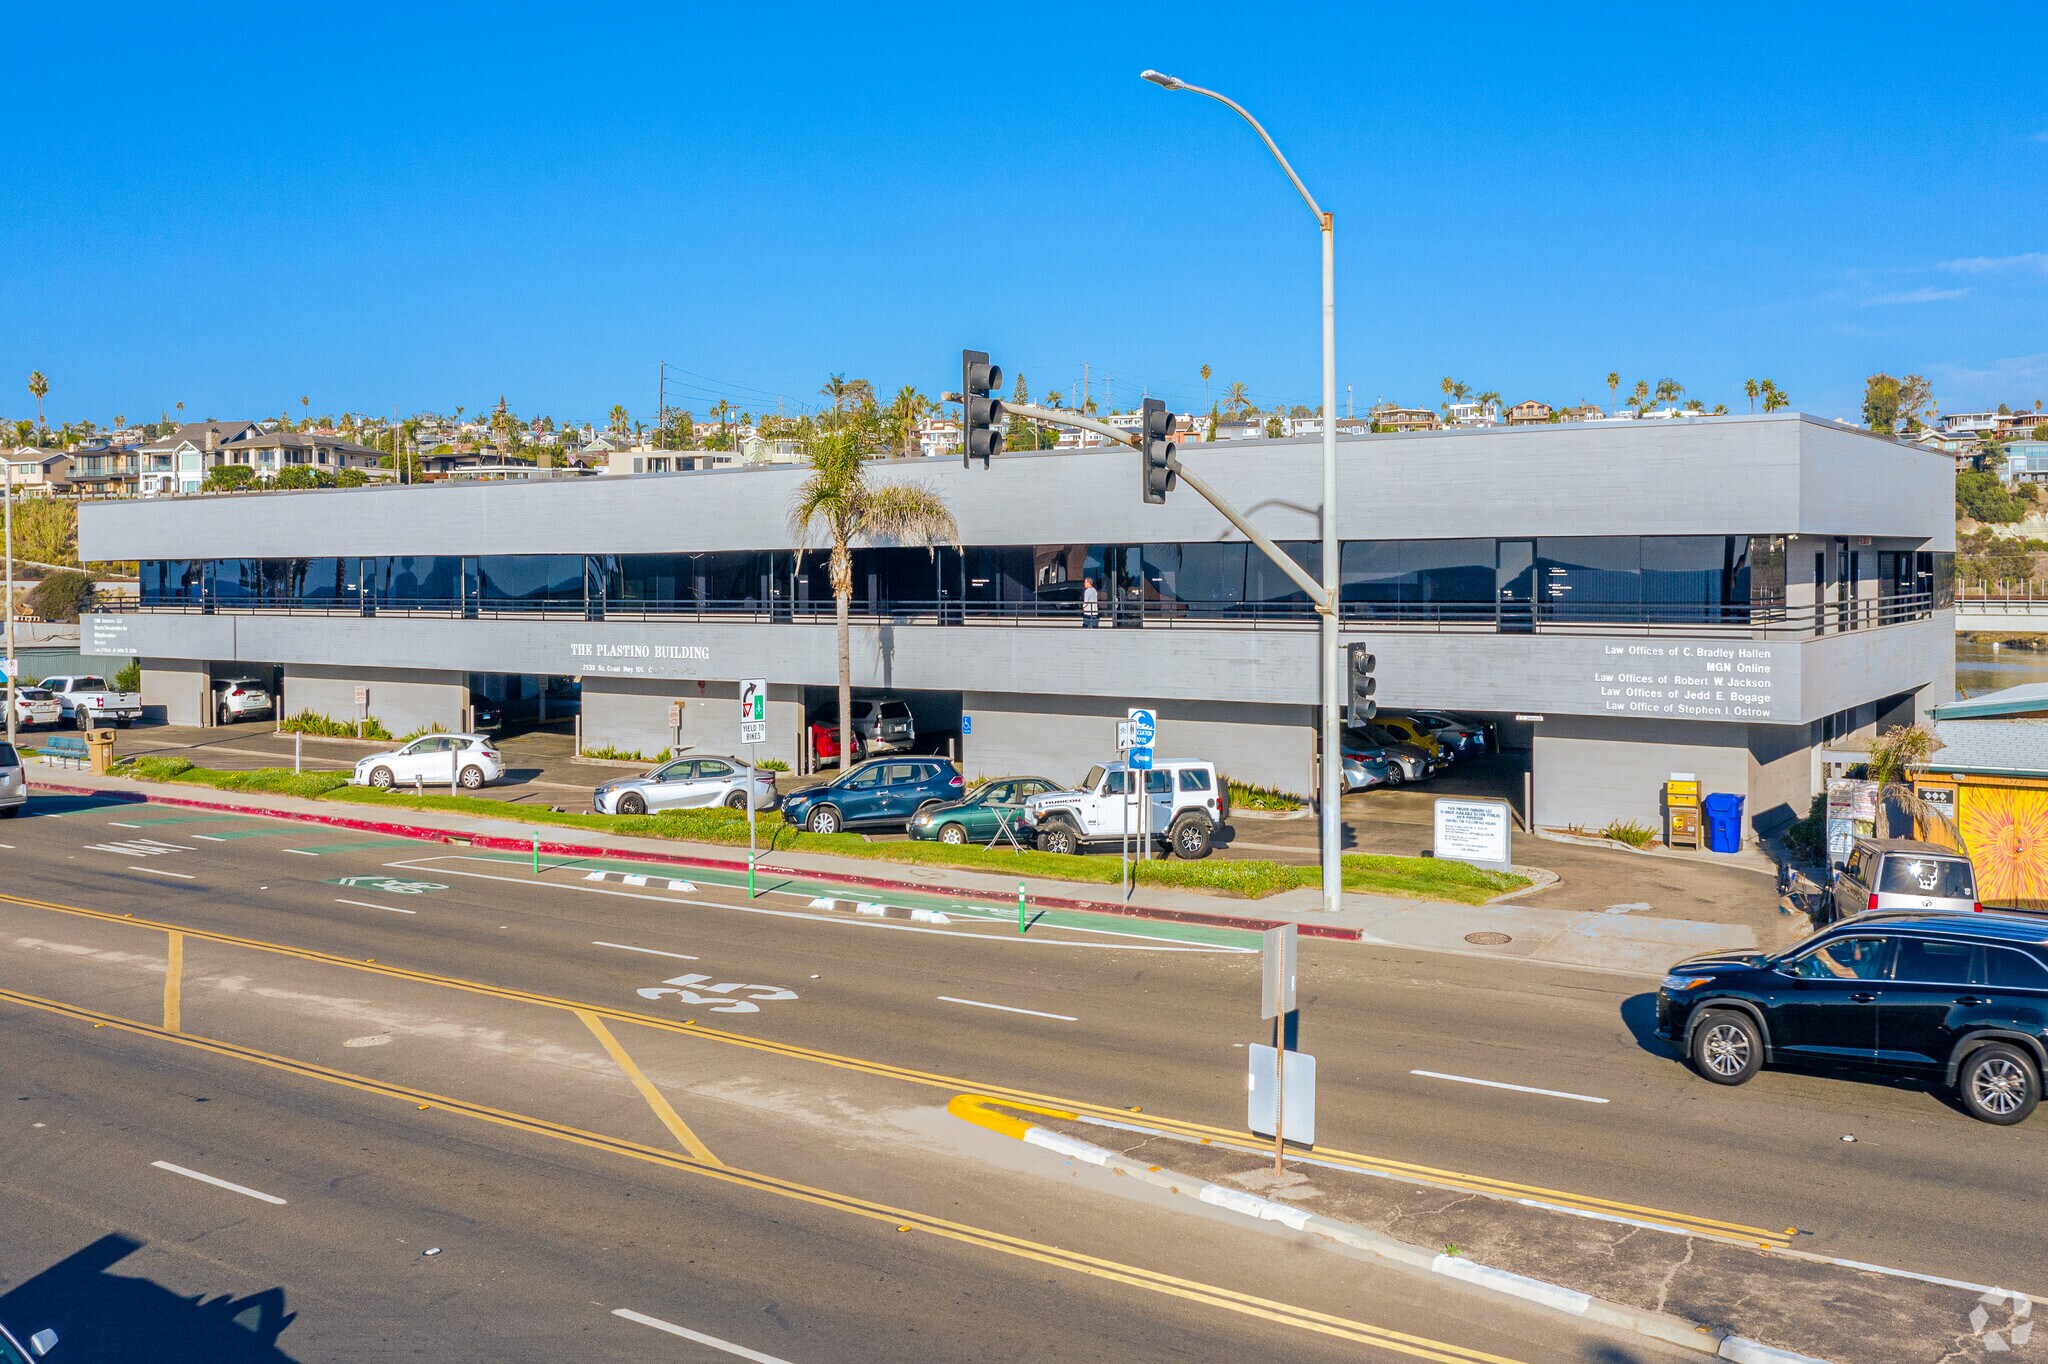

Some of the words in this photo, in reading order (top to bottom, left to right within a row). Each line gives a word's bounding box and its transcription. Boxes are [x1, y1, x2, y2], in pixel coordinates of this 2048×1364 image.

[571, 644, 591, 656] THE
[597, 644, 649, 658] PLASTINO
[654, 645, 710, 660] BUILDING
[1605, 645, 1624, 655] Law
[1629, 646, 1664, 656] Offices
[1669, 647, 1680, 656] of
[1683, 647, 1694, 657] C.
[1697, 648, 1734, 660] Bradley
[1738, 649, 1771, 659] Hallen
[1706, 662, 1731, 672] MGN
[1737, 663, 1771, 674] Online
[1594, 673, 1614, 682] Law
[1618, 673, 1653, 684] Offices
[1658, 675, 1668, 684] of
[1674, 676, 1709, 686] Robert
[1714, 677, 1725, 687] W.
[1727, 677, 1771, 688] Jackson
[1601, 687, 1620, 697] Law
[1626, 688, 1663, 698] Offices
[1668, 690, 1679, 699] of
[1684, 690, 1710, 700] Jedd
[1716, 691, 1726, 701] E.
[1730, 692, 1771, 704] Bogage
[1606, 701, 1625, 710] Law
[1629, 702, 1659, 712] Office
[1664, 703, 1675, 713] of
[1677, 704, 1721, 716] Stephen
[1725, 706, 1731, 716] I.
[1734, 707, 1771, 717] Ostrow
[743, 724, 757, 732] YIELD
[746, 733, 761, 741] BIKES
[636, 973, 800, 1014] 35
